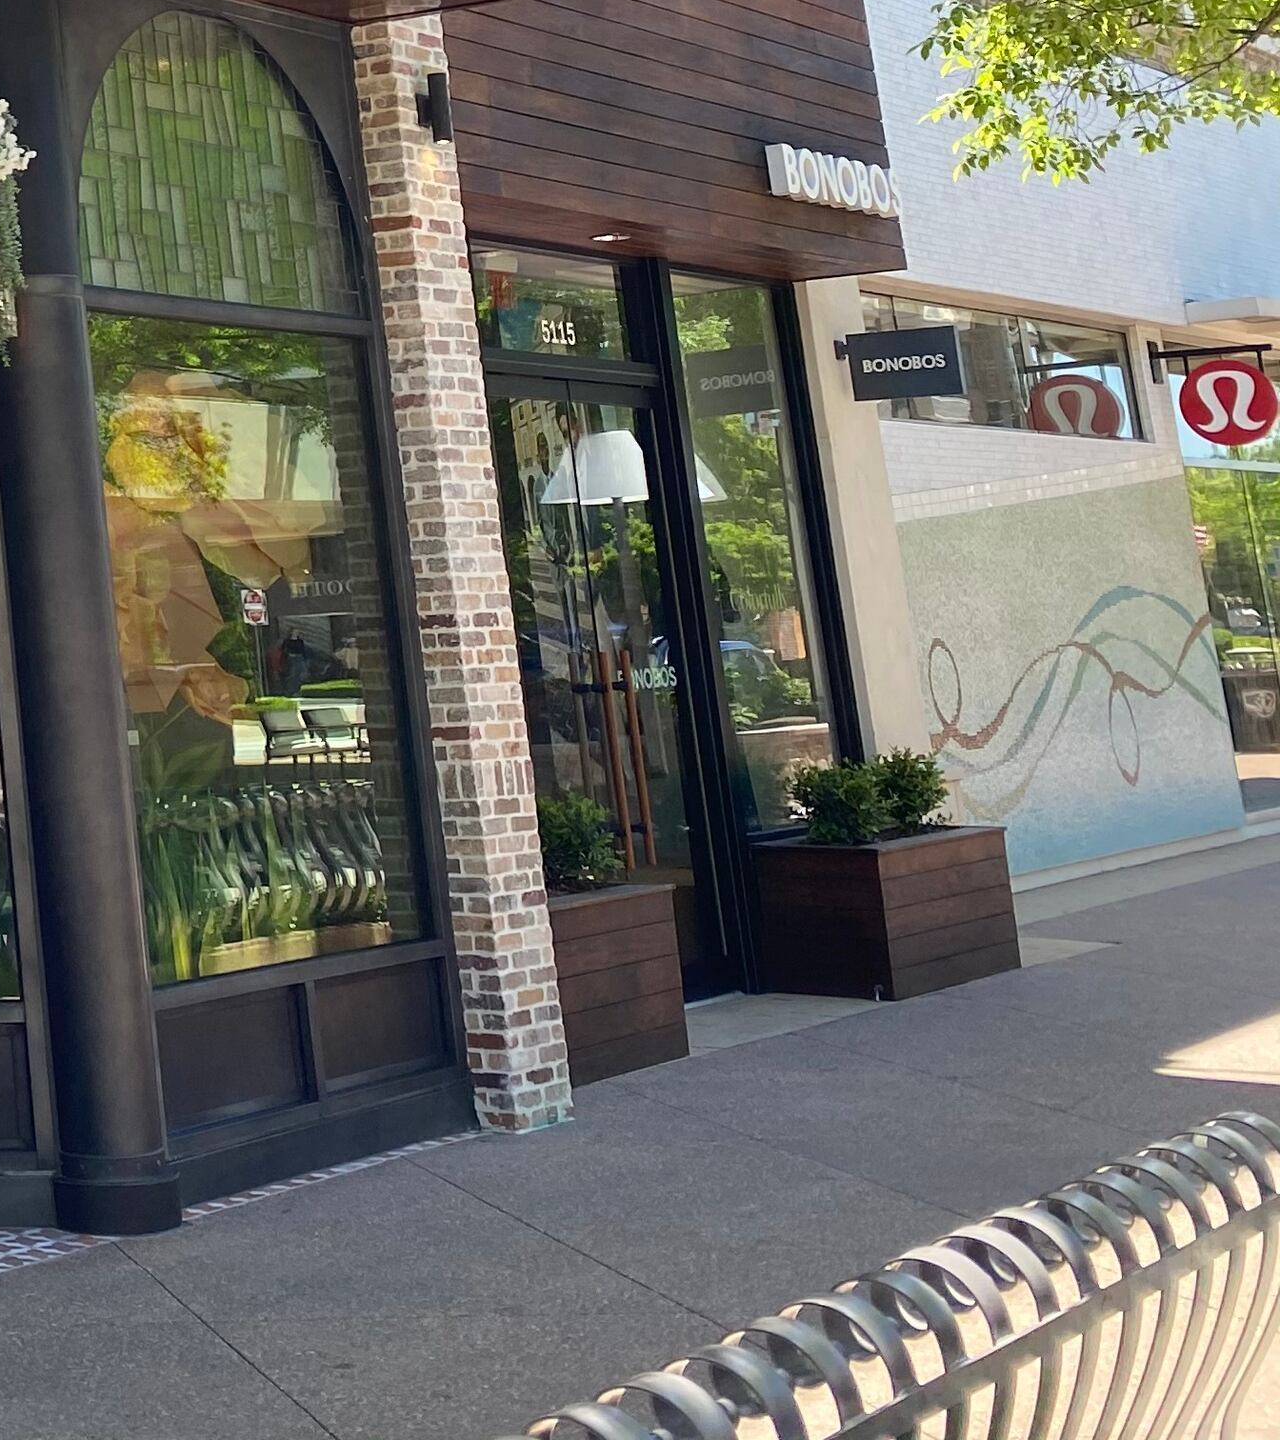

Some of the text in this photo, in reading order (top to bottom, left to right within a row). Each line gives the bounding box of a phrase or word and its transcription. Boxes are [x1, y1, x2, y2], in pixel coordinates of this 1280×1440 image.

[766, 143, 903, 218] BONOBOS
[541, 319, 576, 346] 5115
[862, 354, 946, 374] BONOBOS
[617, 665, 678, 692] NOBOS
